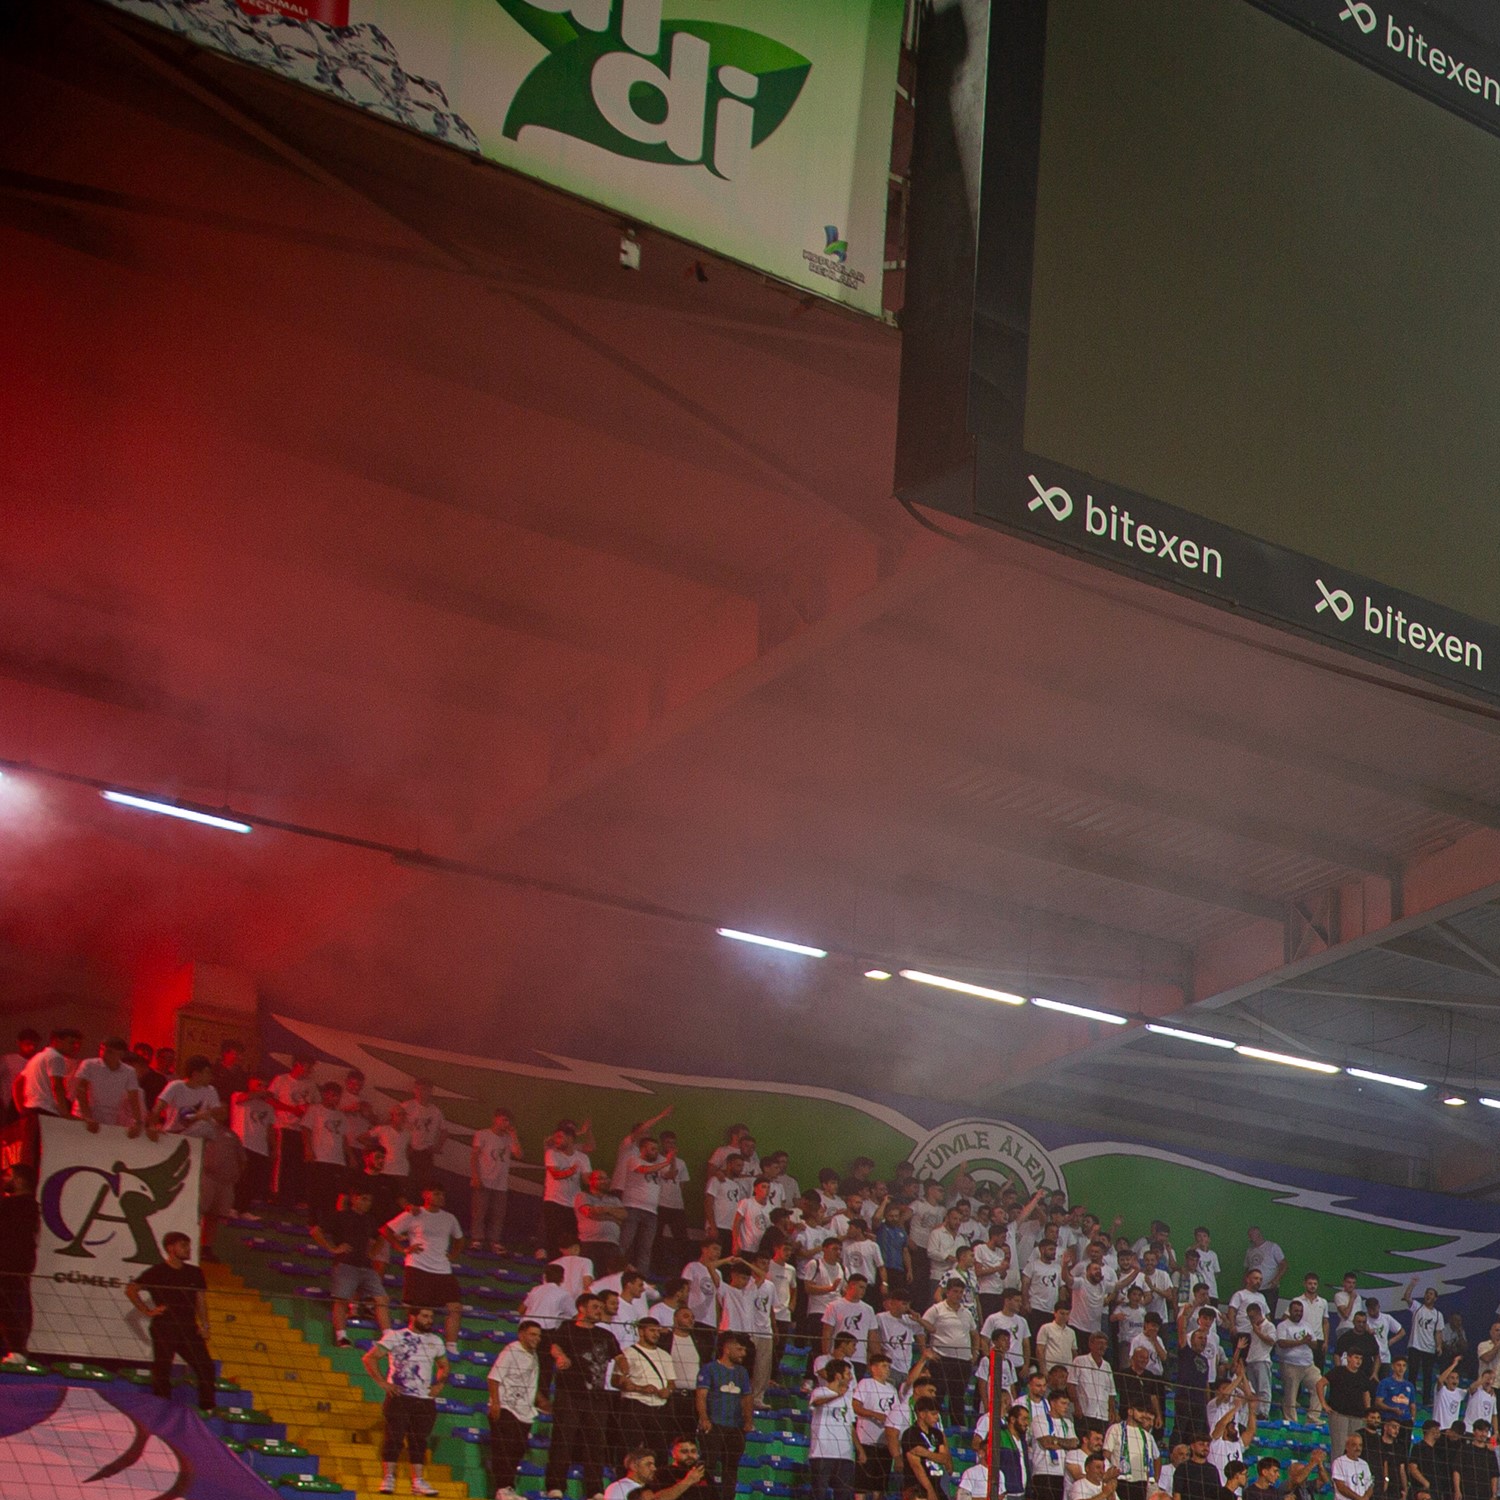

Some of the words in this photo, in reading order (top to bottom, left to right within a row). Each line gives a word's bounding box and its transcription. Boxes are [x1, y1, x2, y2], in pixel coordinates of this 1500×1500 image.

[1387, 15, 1500, 105] bitexen
[1085, 495, 1223, 579] bitexen
[1364, 597, 1483, 672] bitexen
